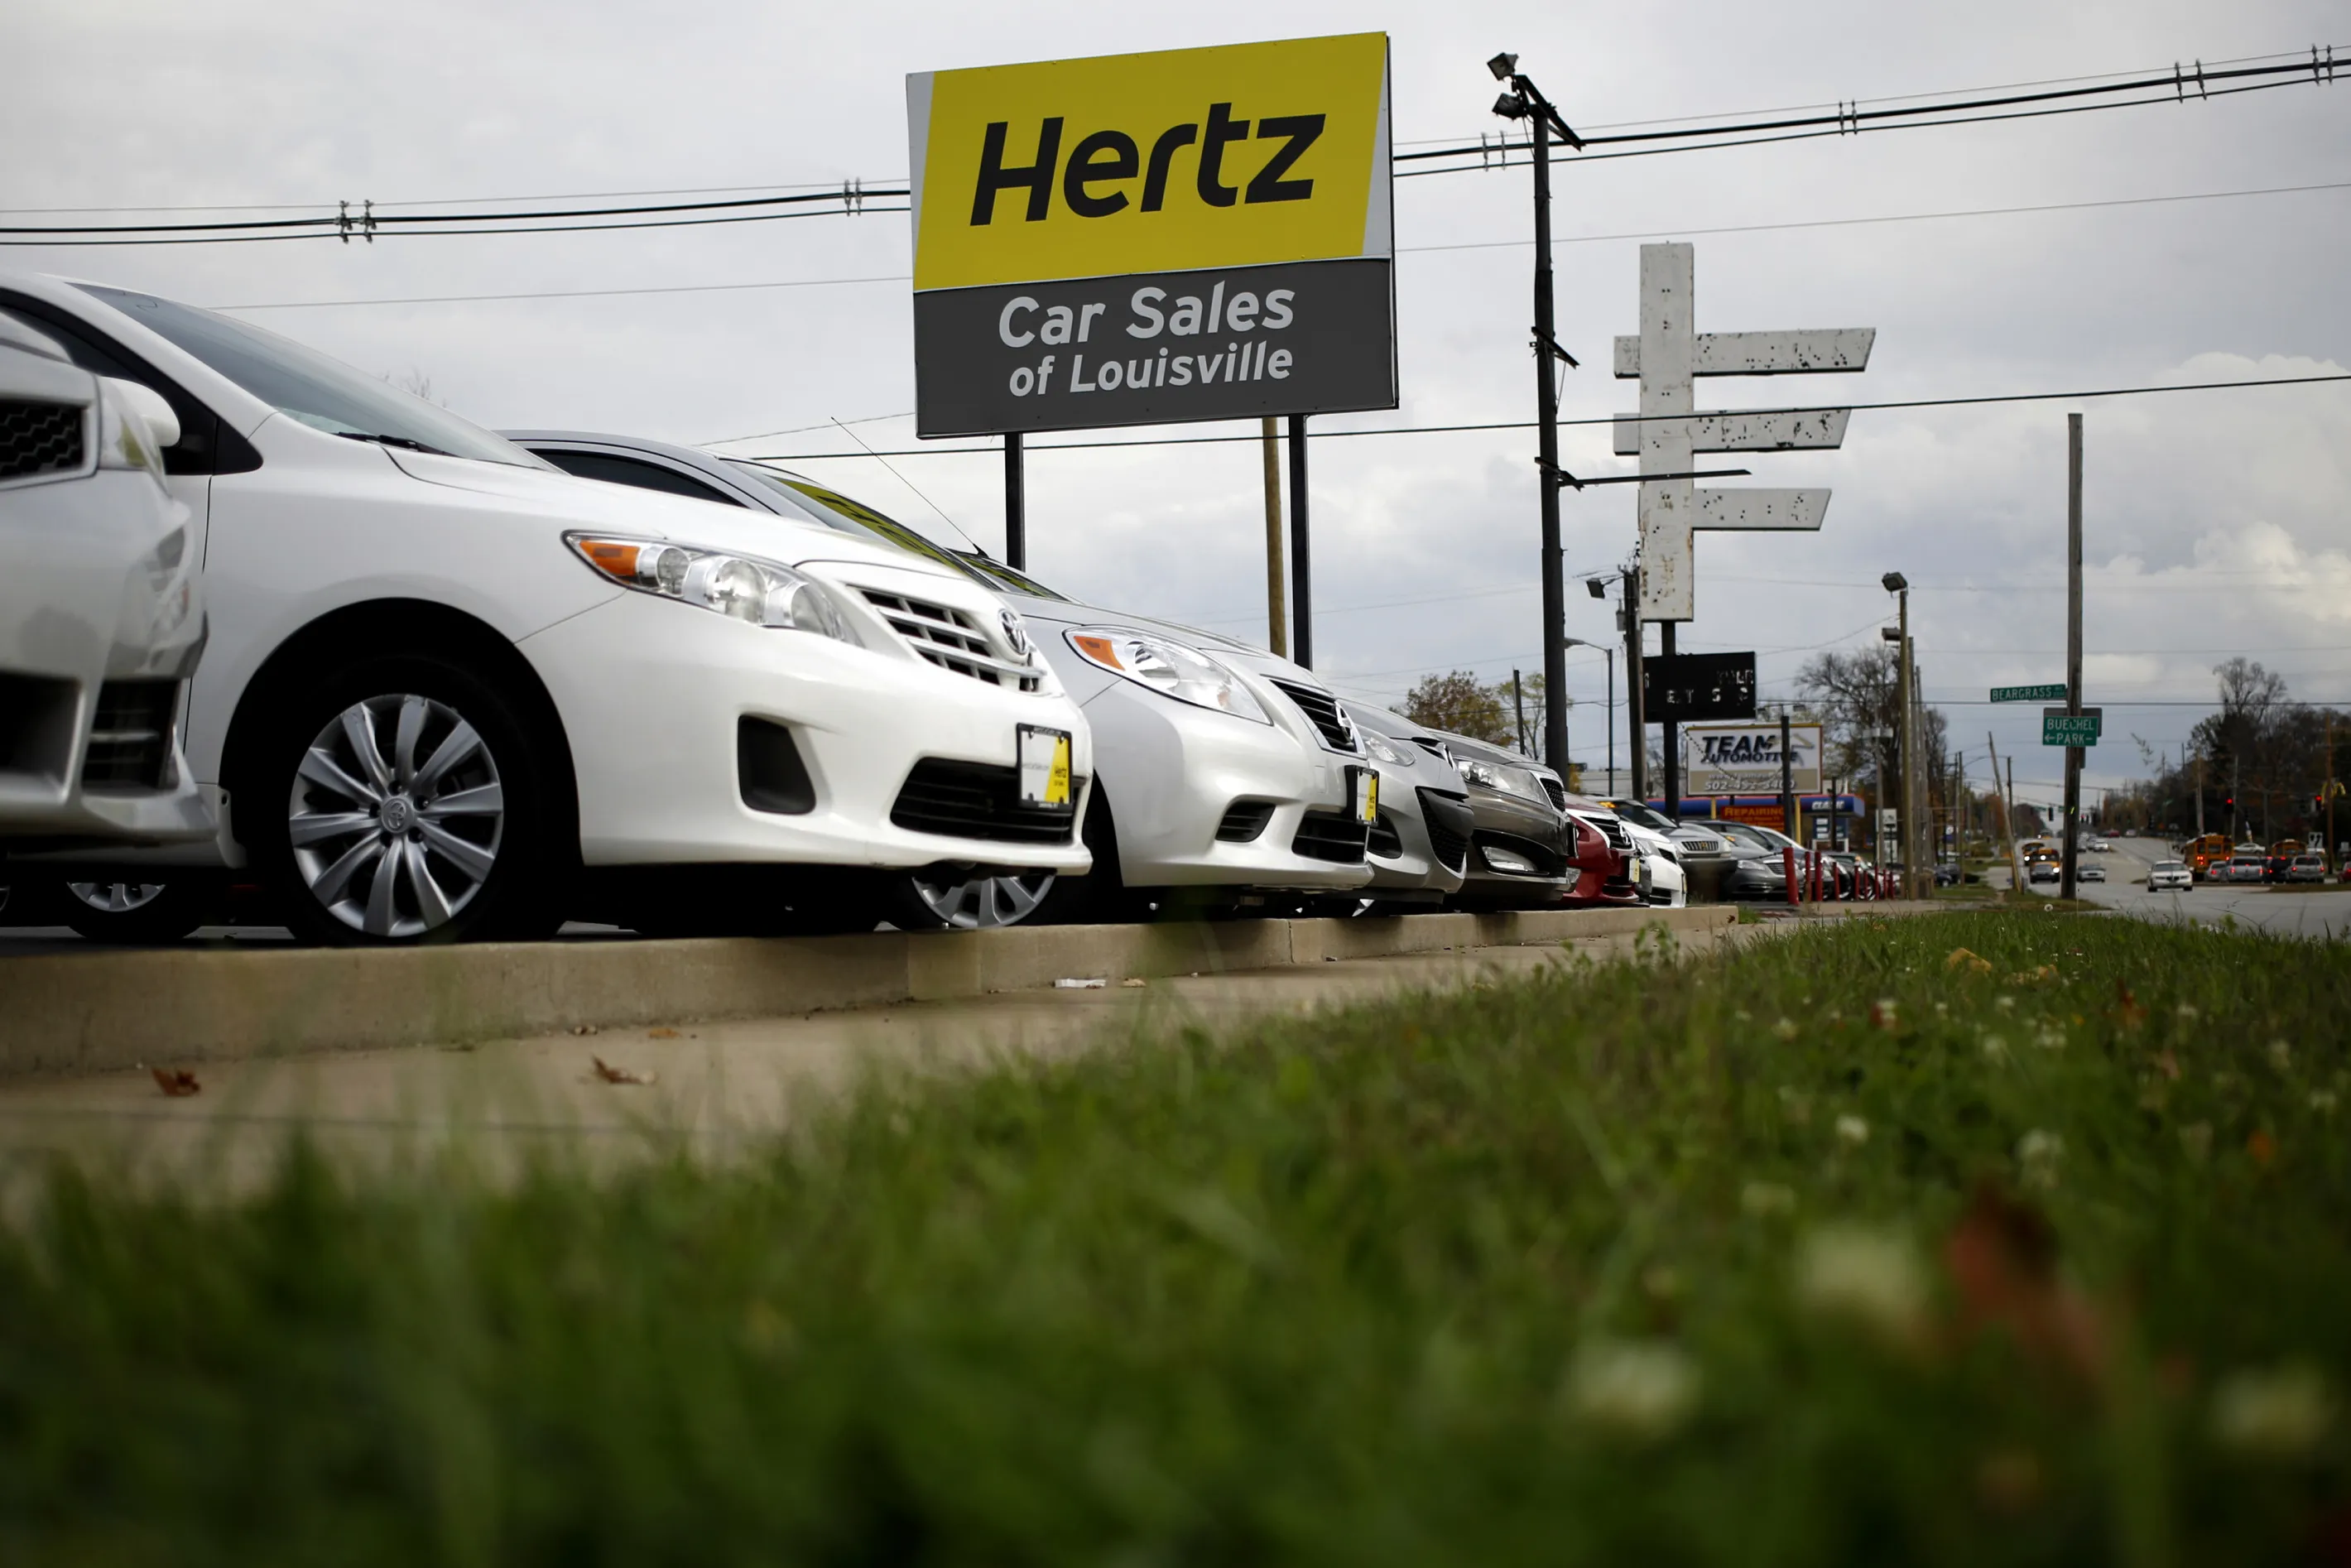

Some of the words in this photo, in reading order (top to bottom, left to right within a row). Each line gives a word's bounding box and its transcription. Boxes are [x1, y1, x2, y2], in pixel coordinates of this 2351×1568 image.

[969, 102, 1326, 226] Hertz
[998, 296, 1106, 349] Car
[1126, 281, 1296, 339] Sales
[1009, 354, 1055, 397] of
[1070, 340, 1293, 393] Louisville
[1992, 686, 2052, 700] BEARGRASS
[2047, 718, 2094, 730] BUECHEL
[1702, 735, 1776, 753] TEAM
[2056, 733, 2084, 744] PARK
